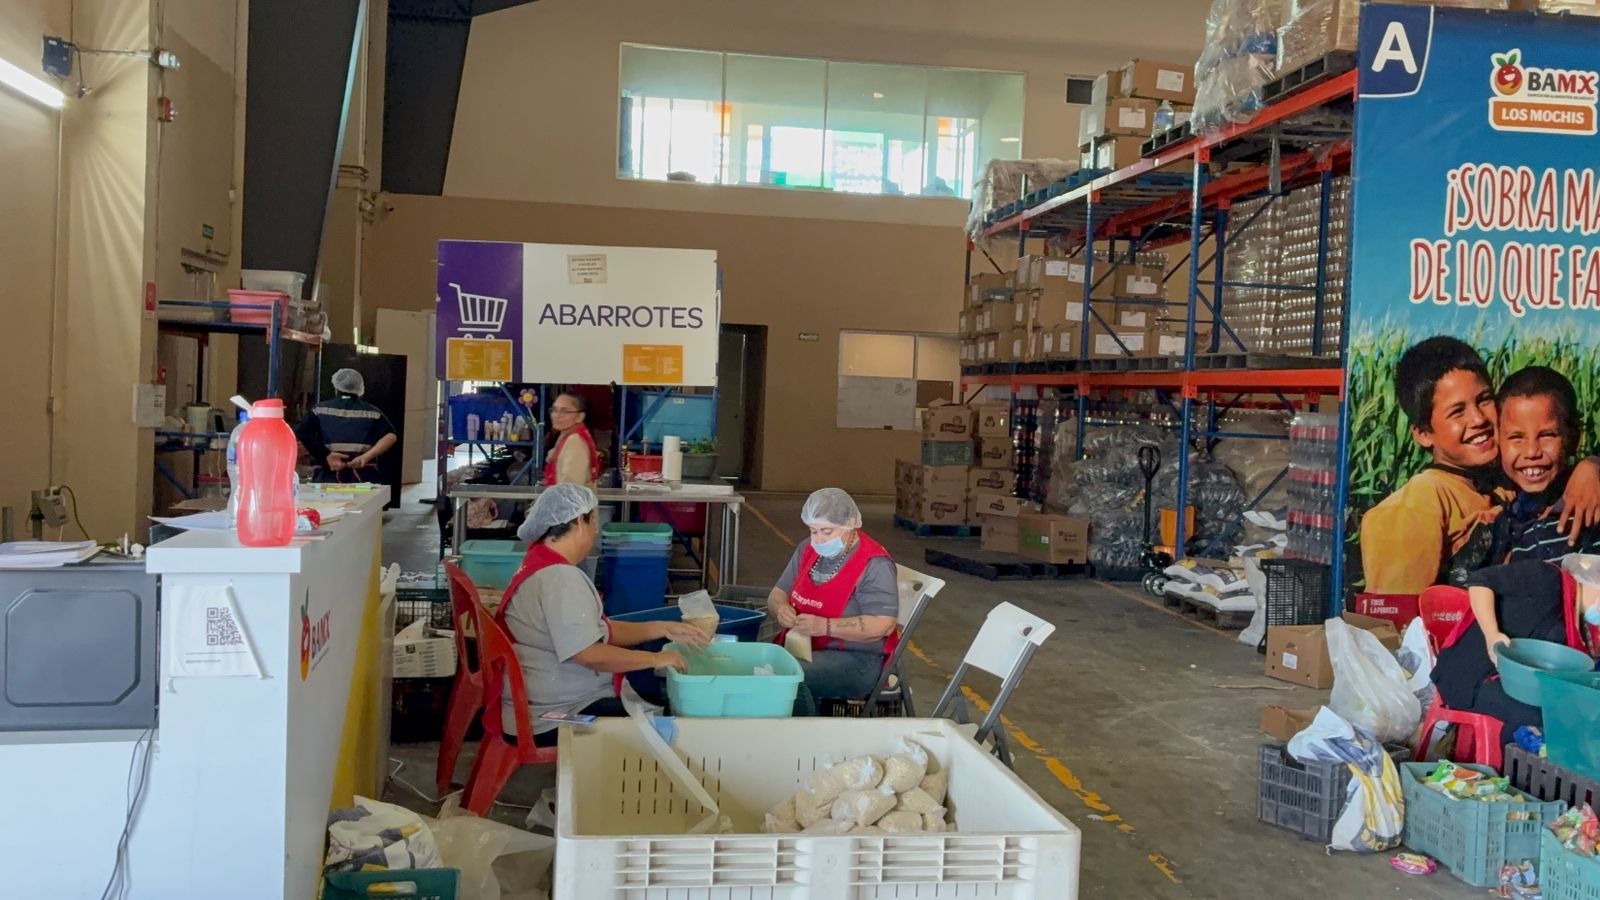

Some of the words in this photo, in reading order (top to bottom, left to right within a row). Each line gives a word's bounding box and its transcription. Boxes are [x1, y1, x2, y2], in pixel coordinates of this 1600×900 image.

[1371, 21, 1418, 74] A
[1527, 71, 1595, 94] BAMX
[1501, 107, 1529, 121] LOS
[1530, 108, 1585, 124] MOCHIS
[1446, 165, 1556, 234] ¡SOBRA
[1411, 239, 1449, 302] DE
[1457, 241, 1494, 306] LO
[1502, 243, 1563, 315] QUE
[538, 303, 703, 329] ABARROTES
[1362, 599, 1367, 614] 1
[312, 609, 331, 660] BAMX
